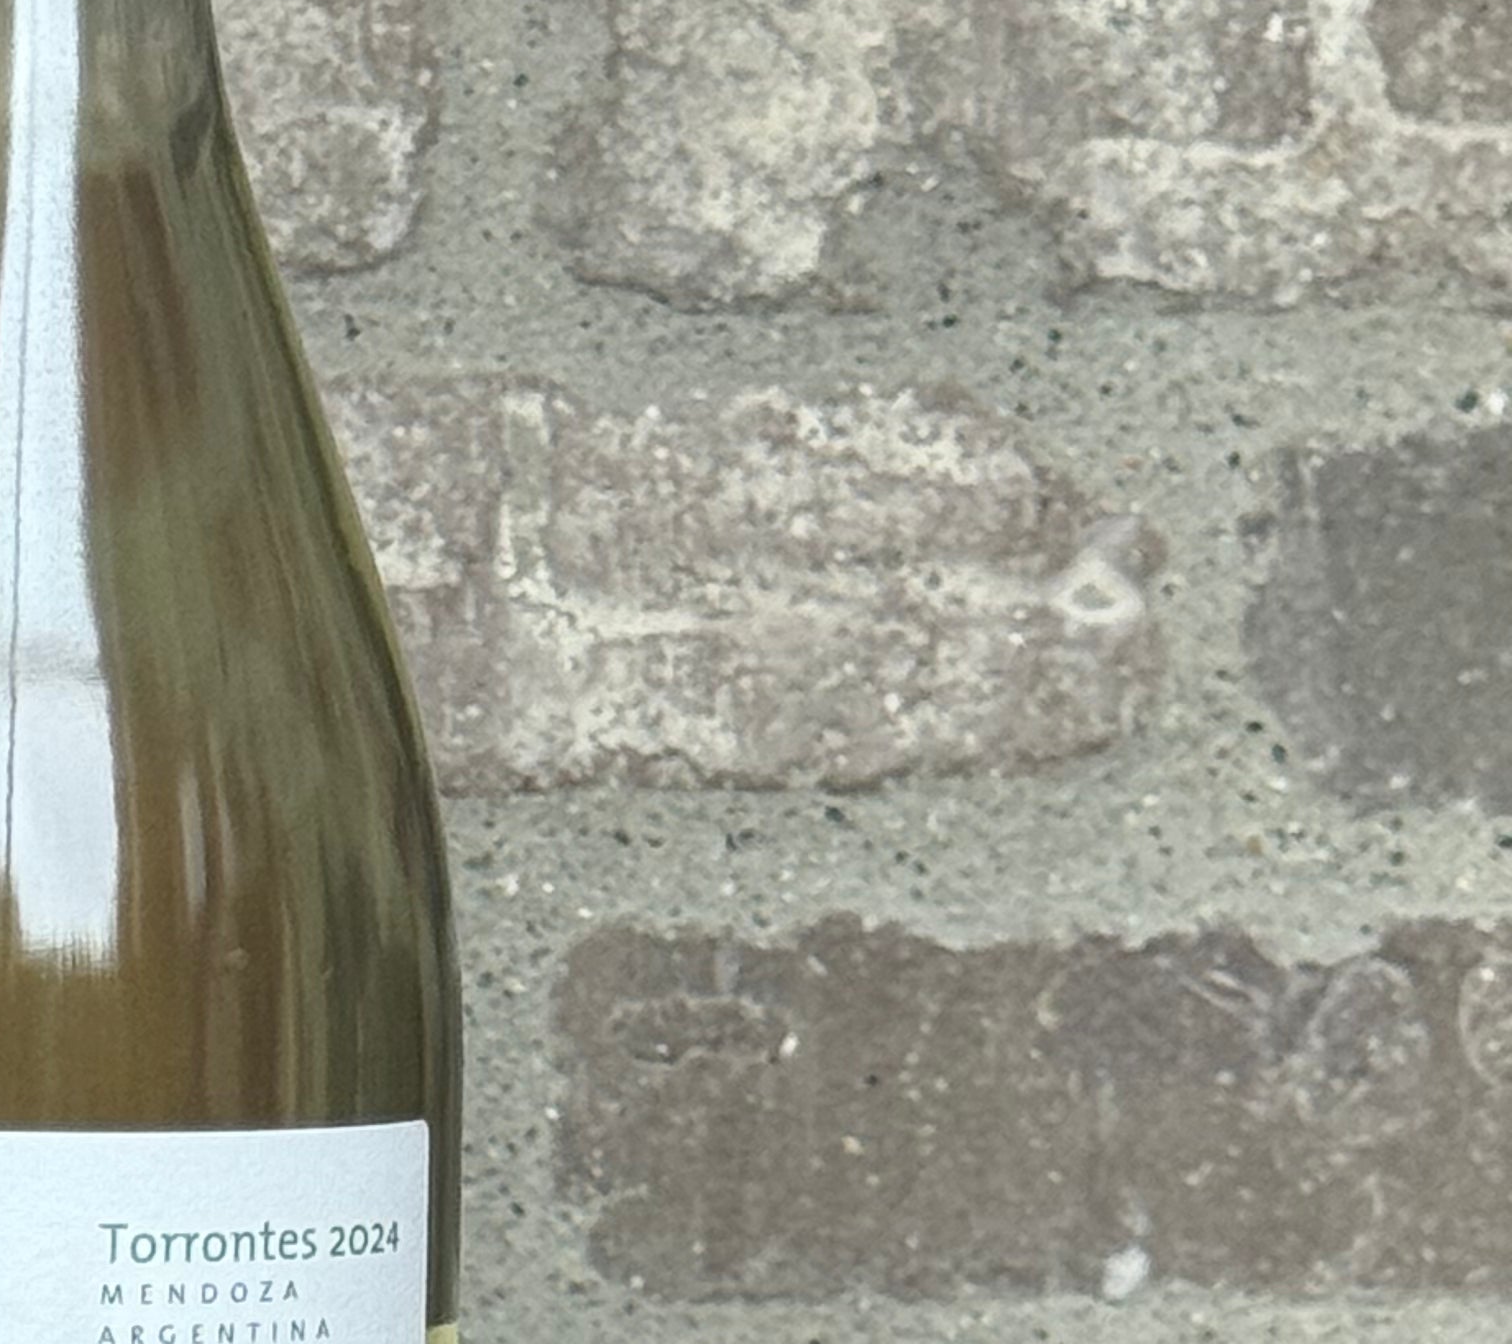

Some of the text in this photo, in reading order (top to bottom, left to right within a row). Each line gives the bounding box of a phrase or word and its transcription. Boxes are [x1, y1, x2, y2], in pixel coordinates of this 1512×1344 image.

[98, 1221, 400, 1263] Torrontes 2024
[99, 1280, 299, 1305] MENDOZA
